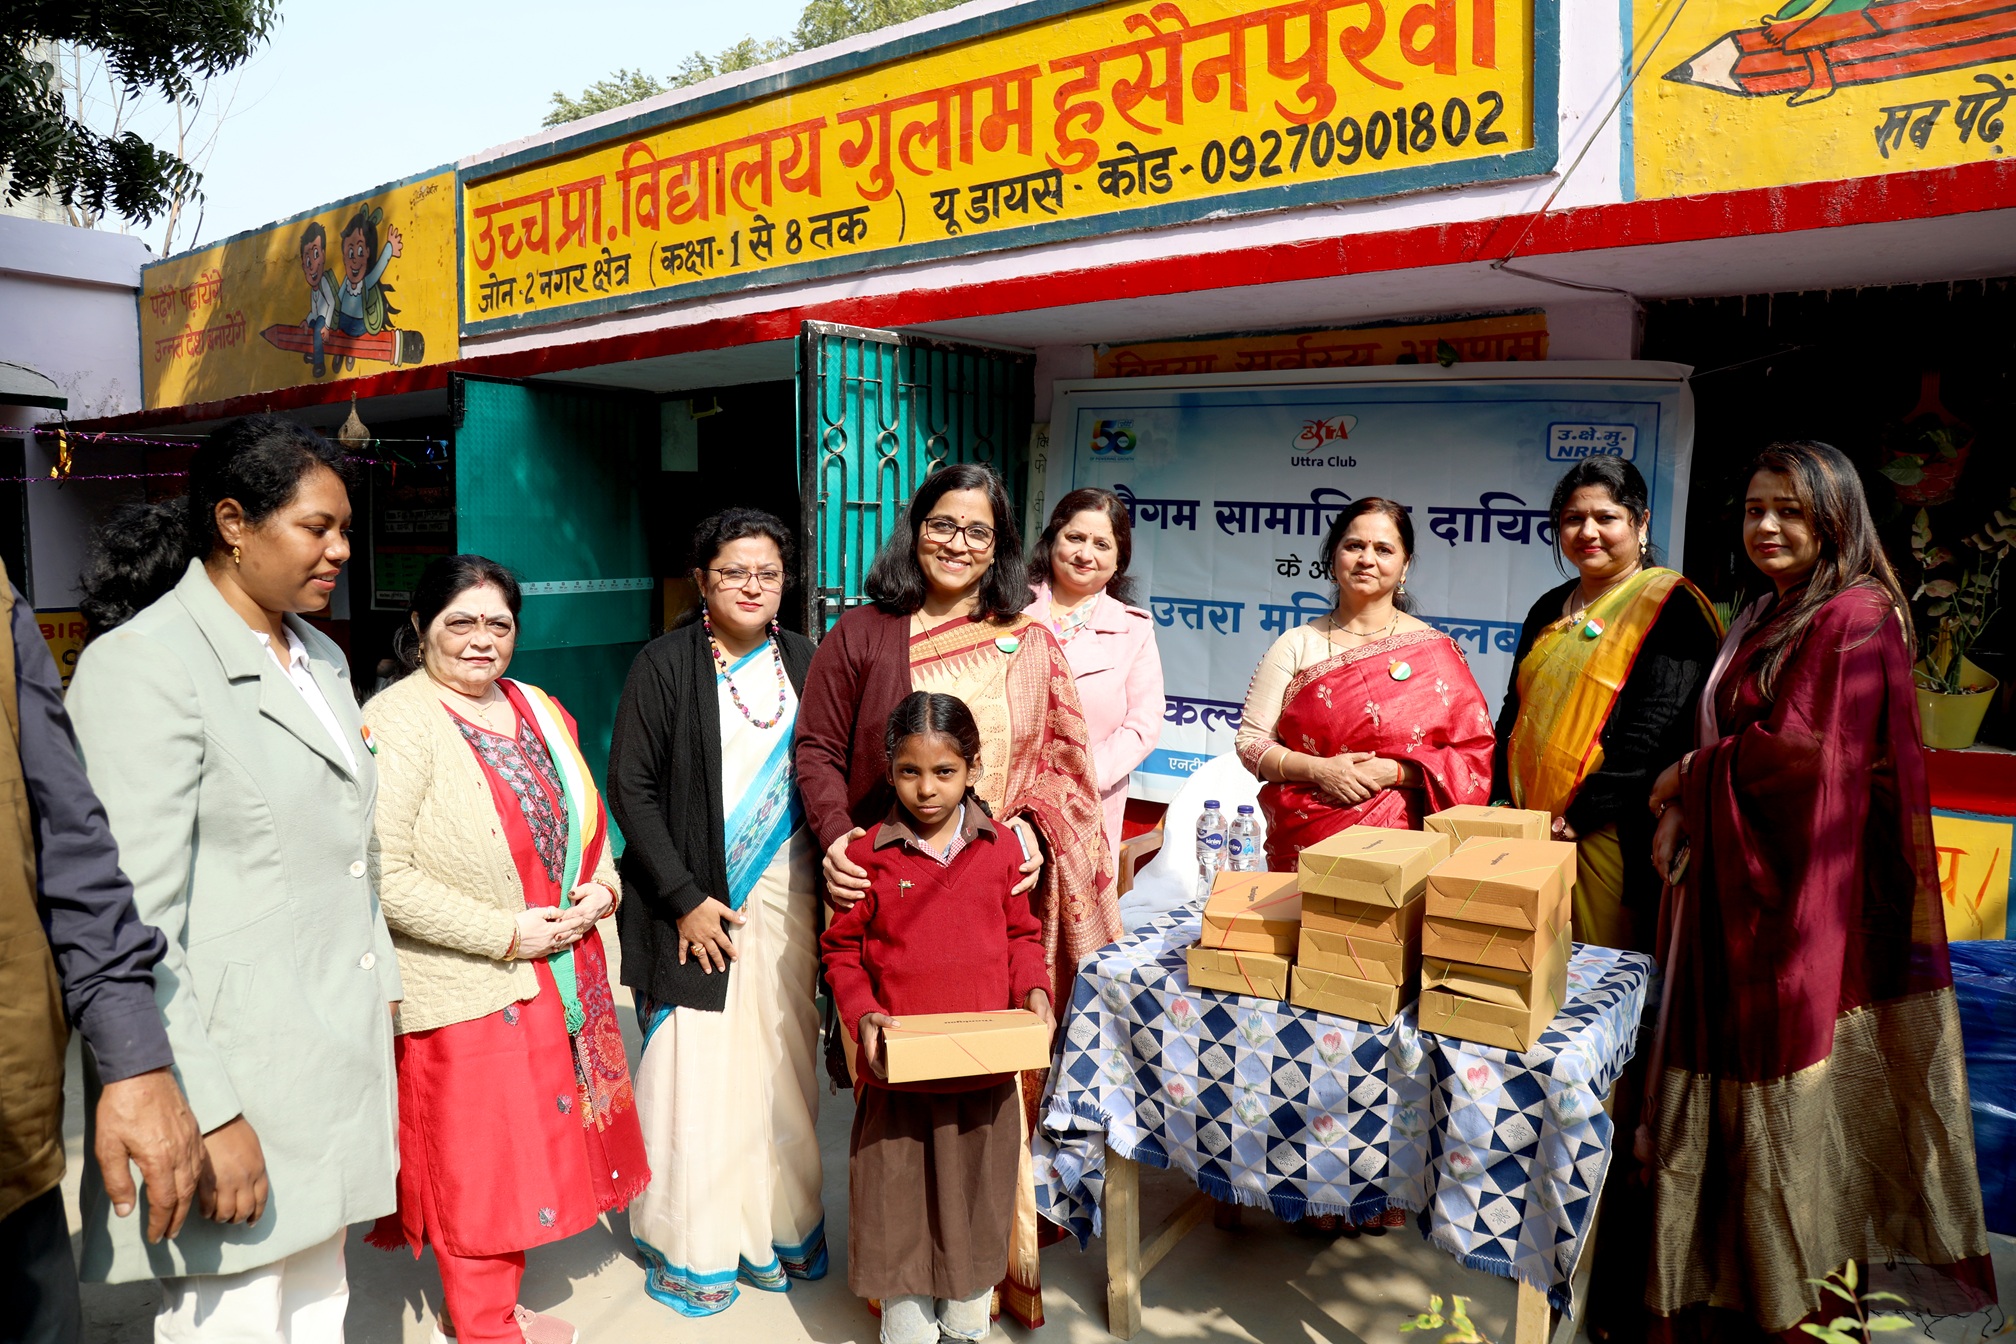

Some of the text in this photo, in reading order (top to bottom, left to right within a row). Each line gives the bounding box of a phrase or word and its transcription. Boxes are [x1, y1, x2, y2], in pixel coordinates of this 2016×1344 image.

[1874, 99, 1951, 159] सब
[472, 187, 555, 271] उच्च
[615, 116, 827, 237] विद्यालय
[836, 64, 1042, 201] गुलाम
[539, 263, 588, 300] नगर
[592, 246, 632, 293] क्षेत्र
[749, 213, 776, 262] से
[785, 218, 803, 255] 8
[808, 205, 871, 250] तक
[930, 187, 962, 235] यू
[154, 334, 184, 363] उन्नत
[184, 323, 206, 358] देश
[1291, 456, 1357, 467] Uttra Club
[1275, 553, 1303, 578] के
[39, 622, 86, 640] BIR
[1149, 596, 1245, 636] उत्तरा
